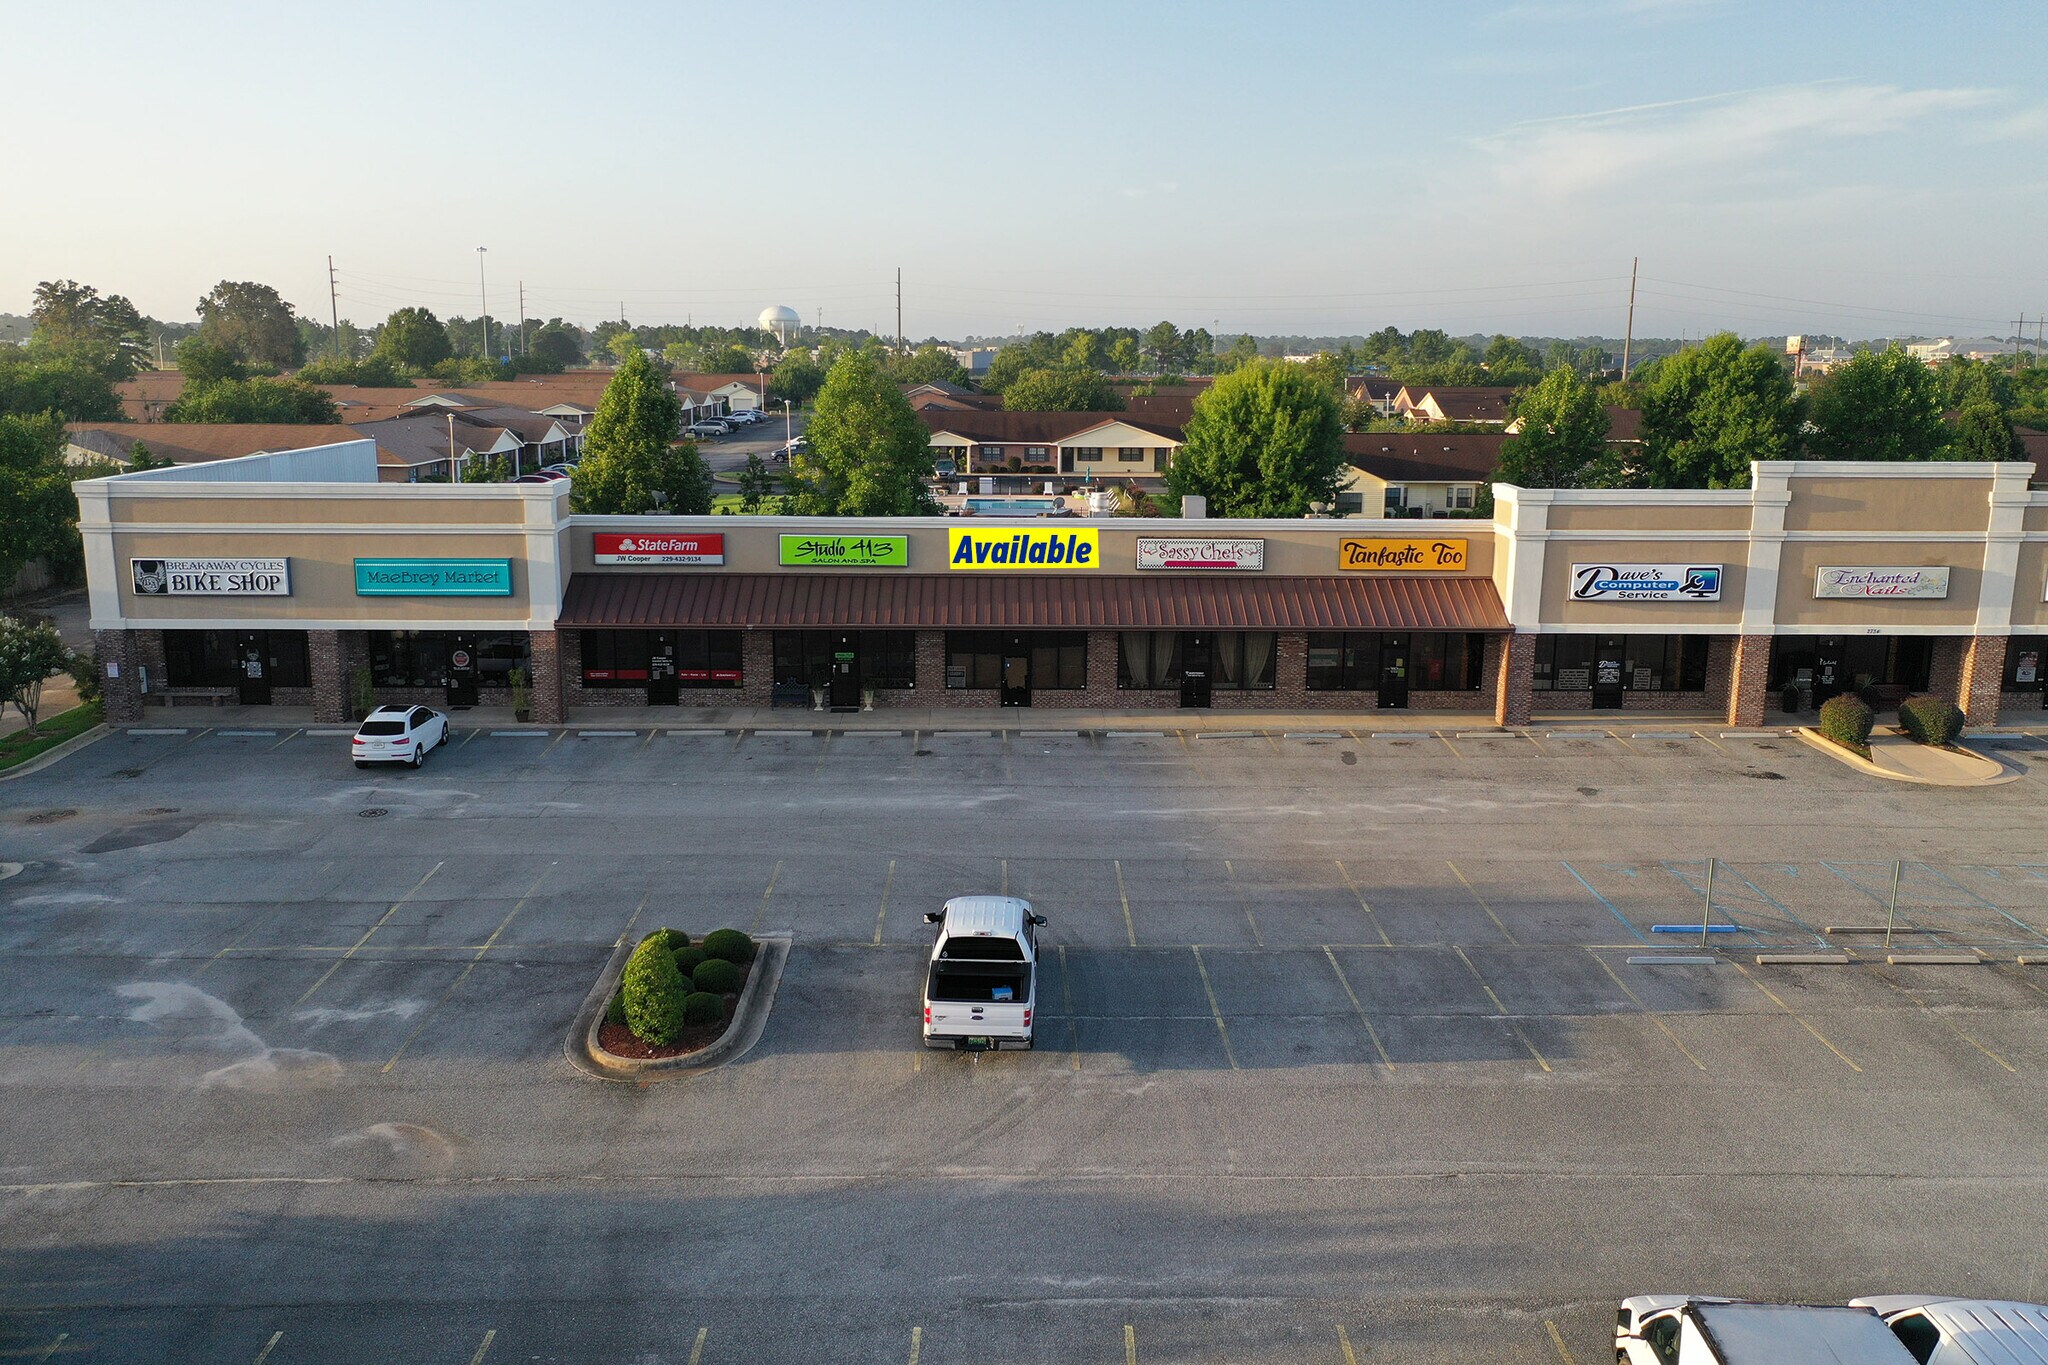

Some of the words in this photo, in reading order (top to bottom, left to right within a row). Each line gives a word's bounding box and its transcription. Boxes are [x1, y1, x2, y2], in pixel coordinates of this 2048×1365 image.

[794, 537, 846, 557] Studio
[850, 539, 893, 557] 413
[1158, 543, 1199, 561] Sassy
[1343, 541, 1424, 567] Tanfastic
[1431, 542, 1463, 565] Too
[166, 561, 239, 571] BREAKAWAY
[240, 561, 285, 571] CYCLES
[628, 555, 651, 563] Cooper
[171, 572, 222, 592] BIKE
[227, 571, 281, 592] SHOP
[367, 570, 440, 586] MaeBrey
[444, 570, 499, 584] Market
[1574, 566, 1663, 598] Dave's
[1598, 581, 1675, 590] Computer
[1821, 569, 1921, 586] Enchanted
[1618, 591, 1669, 599] Service
[1840, 584, 1909, 597] Nails
